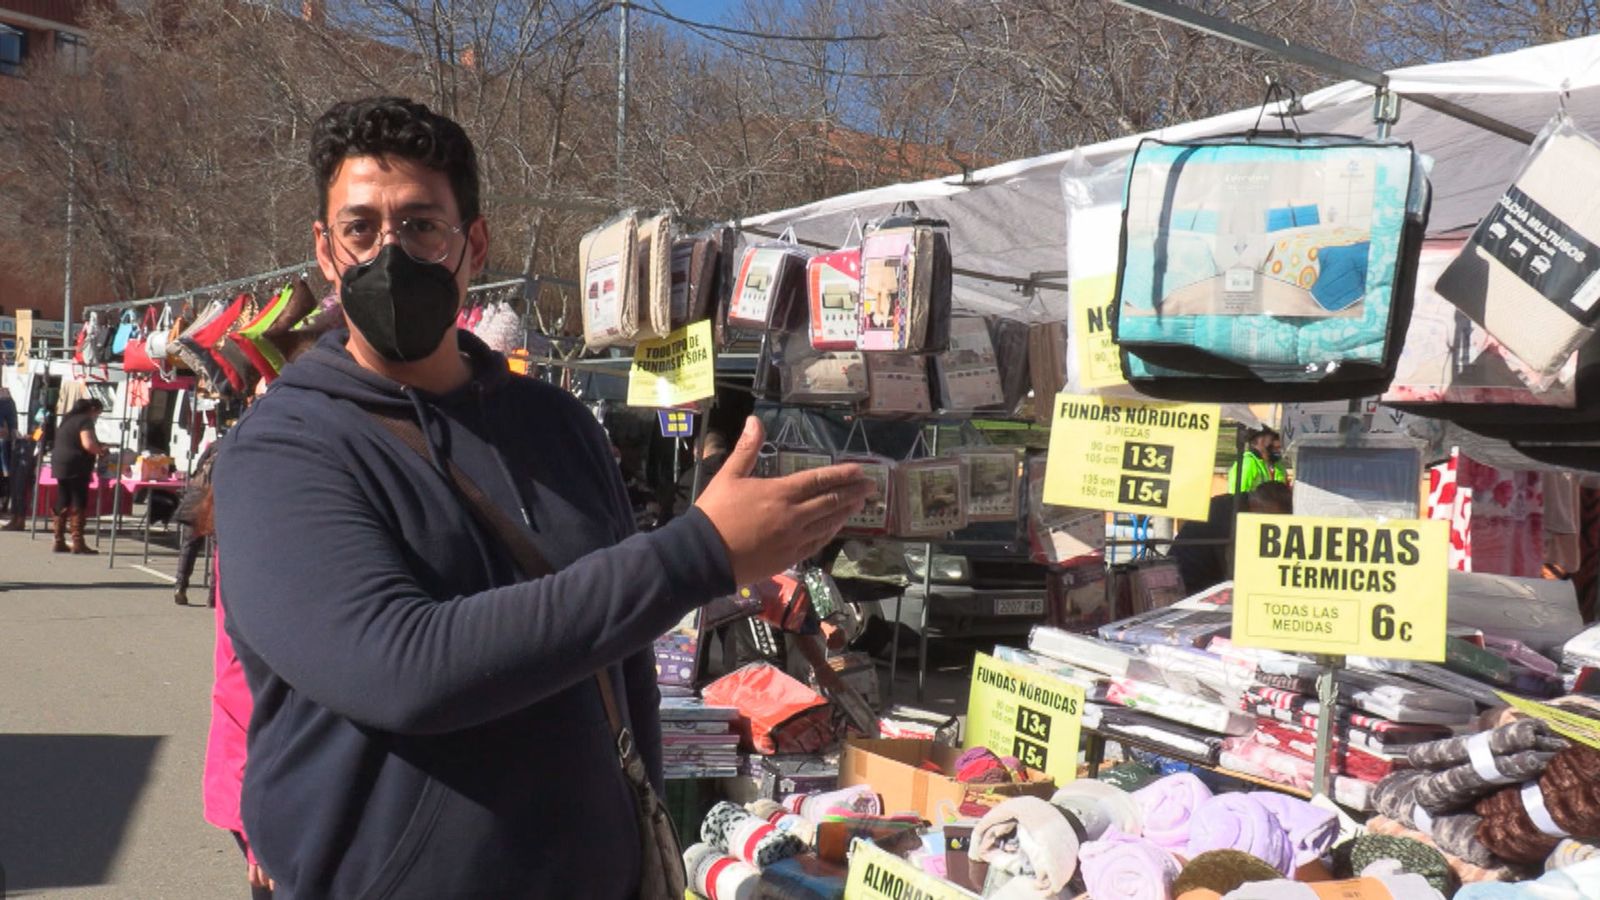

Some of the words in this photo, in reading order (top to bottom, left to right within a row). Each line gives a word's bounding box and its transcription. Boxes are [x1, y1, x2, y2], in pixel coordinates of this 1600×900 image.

[1527, 215, 1587, 264] MULTIUSOS
[646, 344, 671, 359] TODO
[671, 339, 687, 352] TIPO
[689, 336, 699, 348] DE
[637, 357, 676, 373] FUNDAS
[676, 353, 685, 368] DE
[1060, 402, 1121, 423] FUNDAS
[1125, 404, 1210, 431] NÓRDICAS
[1113, 425, 1151, 439] PIEZAS
[1103, 456, 1119, 464] cm
[1104, 444, 1120, 453] cm
[1130, 445, 1167, 469] 13€
[1099, 489, 1114, 498] cm
[1100, 478, 1116, 486] cm
[1126, 478, 1163, 503] 15€
[1259, 523, 1420, 566] BAJERAS
[1278, 561, 1397, 593] TÉRMICAS
[1263, 602, 1309, 618] TODAS
[1312, 605, 1340, 619] LAS
[1271, 619, 1334, 634] MEDIDAS
[976, 666, 1016, 694] FUNDAS
[1022, 710, 1047, 737] 13€
[1018, 742, 1043, 768] 15€
